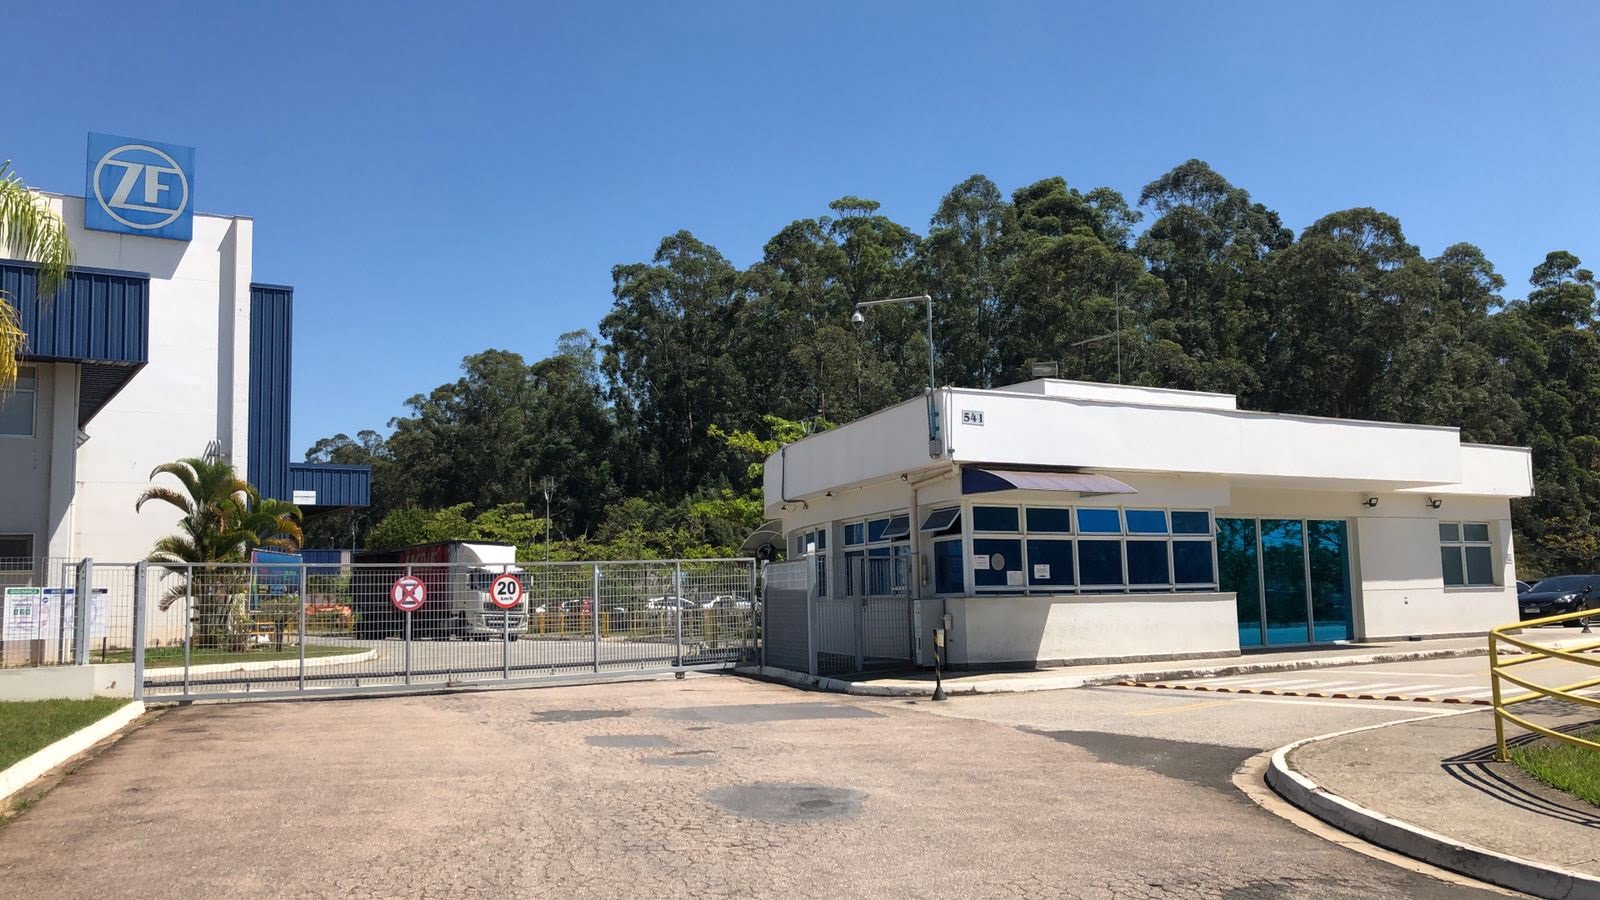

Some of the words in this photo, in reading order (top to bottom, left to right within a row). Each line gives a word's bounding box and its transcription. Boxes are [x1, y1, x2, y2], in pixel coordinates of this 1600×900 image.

[101, 159, 181, 214] ZF
[963, 412, 983, 423] 541
[497, 581, 516, 595] 20
